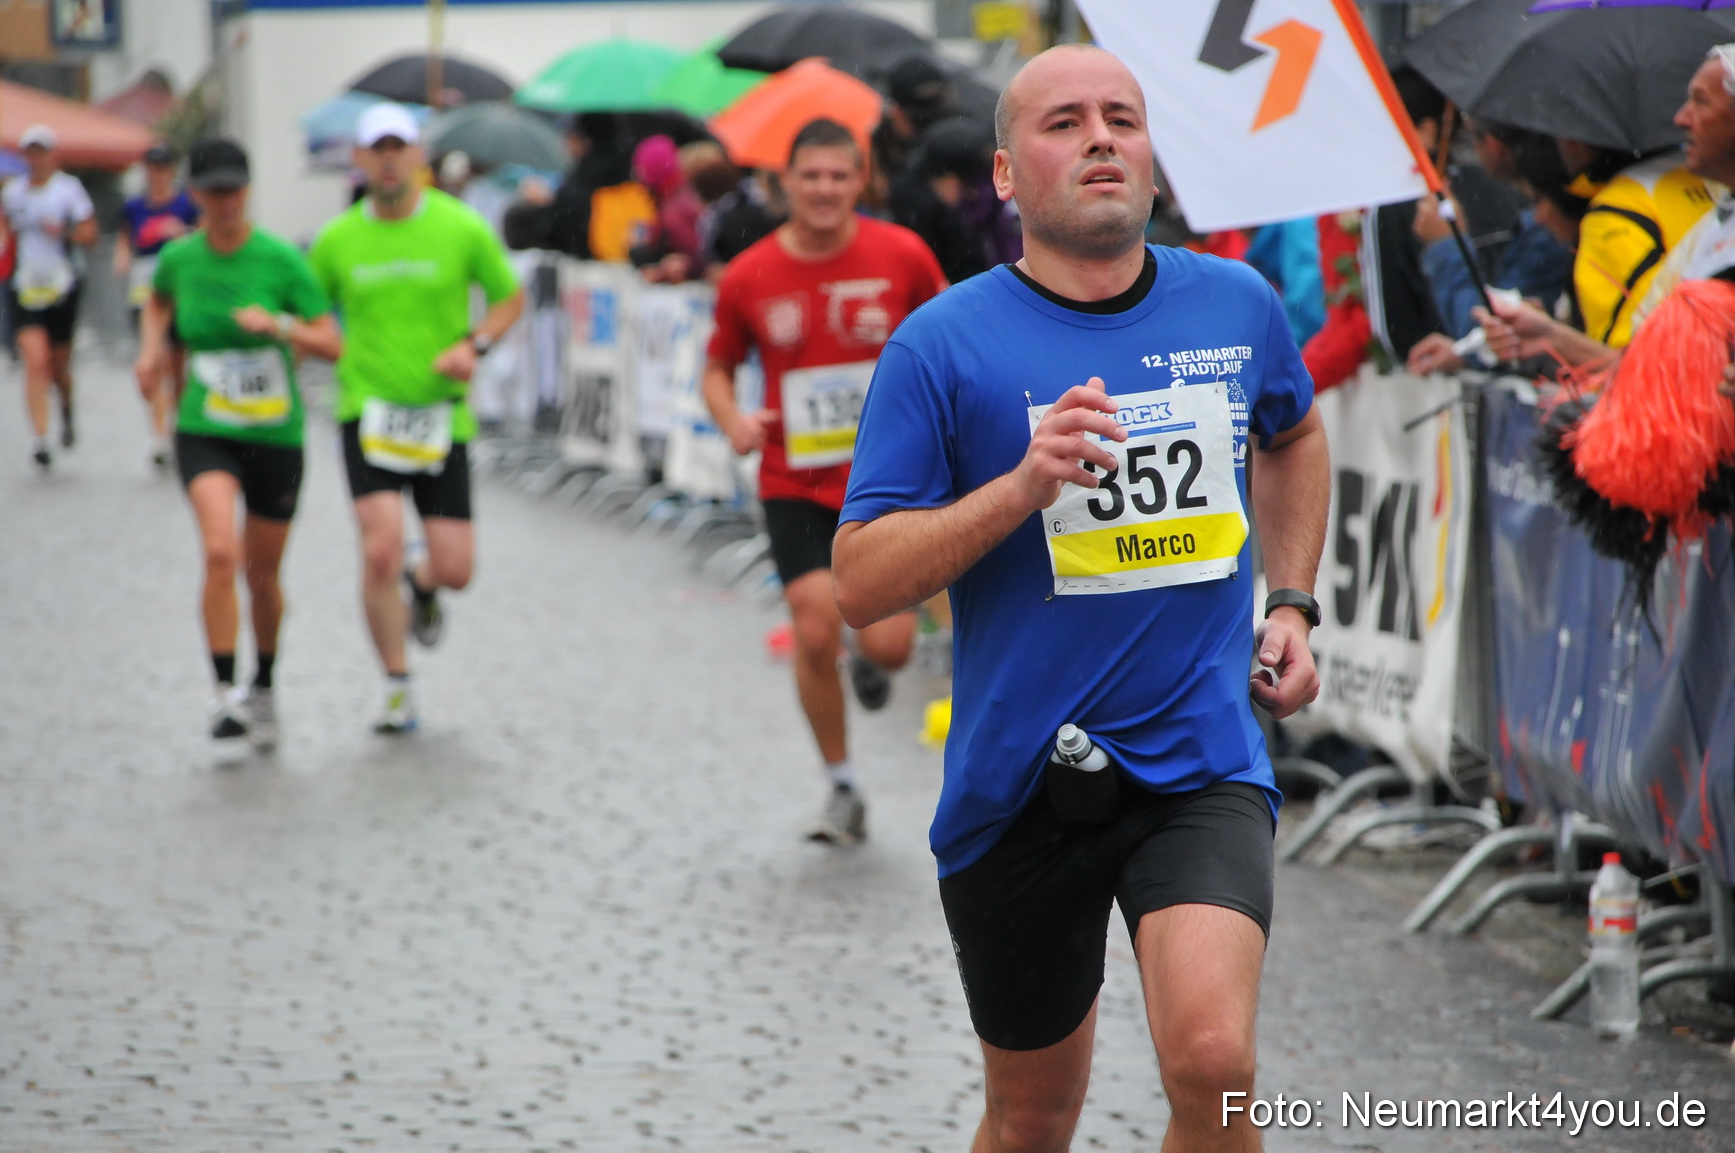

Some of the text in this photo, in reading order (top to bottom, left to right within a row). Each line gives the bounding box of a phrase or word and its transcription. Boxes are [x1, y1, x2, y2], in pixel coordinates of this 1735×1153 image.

[1141, 346, 1252, 368] 12. NEUMARKTER
[1170, 360, 1243, 378] STADTLAUF
[1083, 439, 1208, 522] 352
[1115, 532, 1196, 563] Marco
